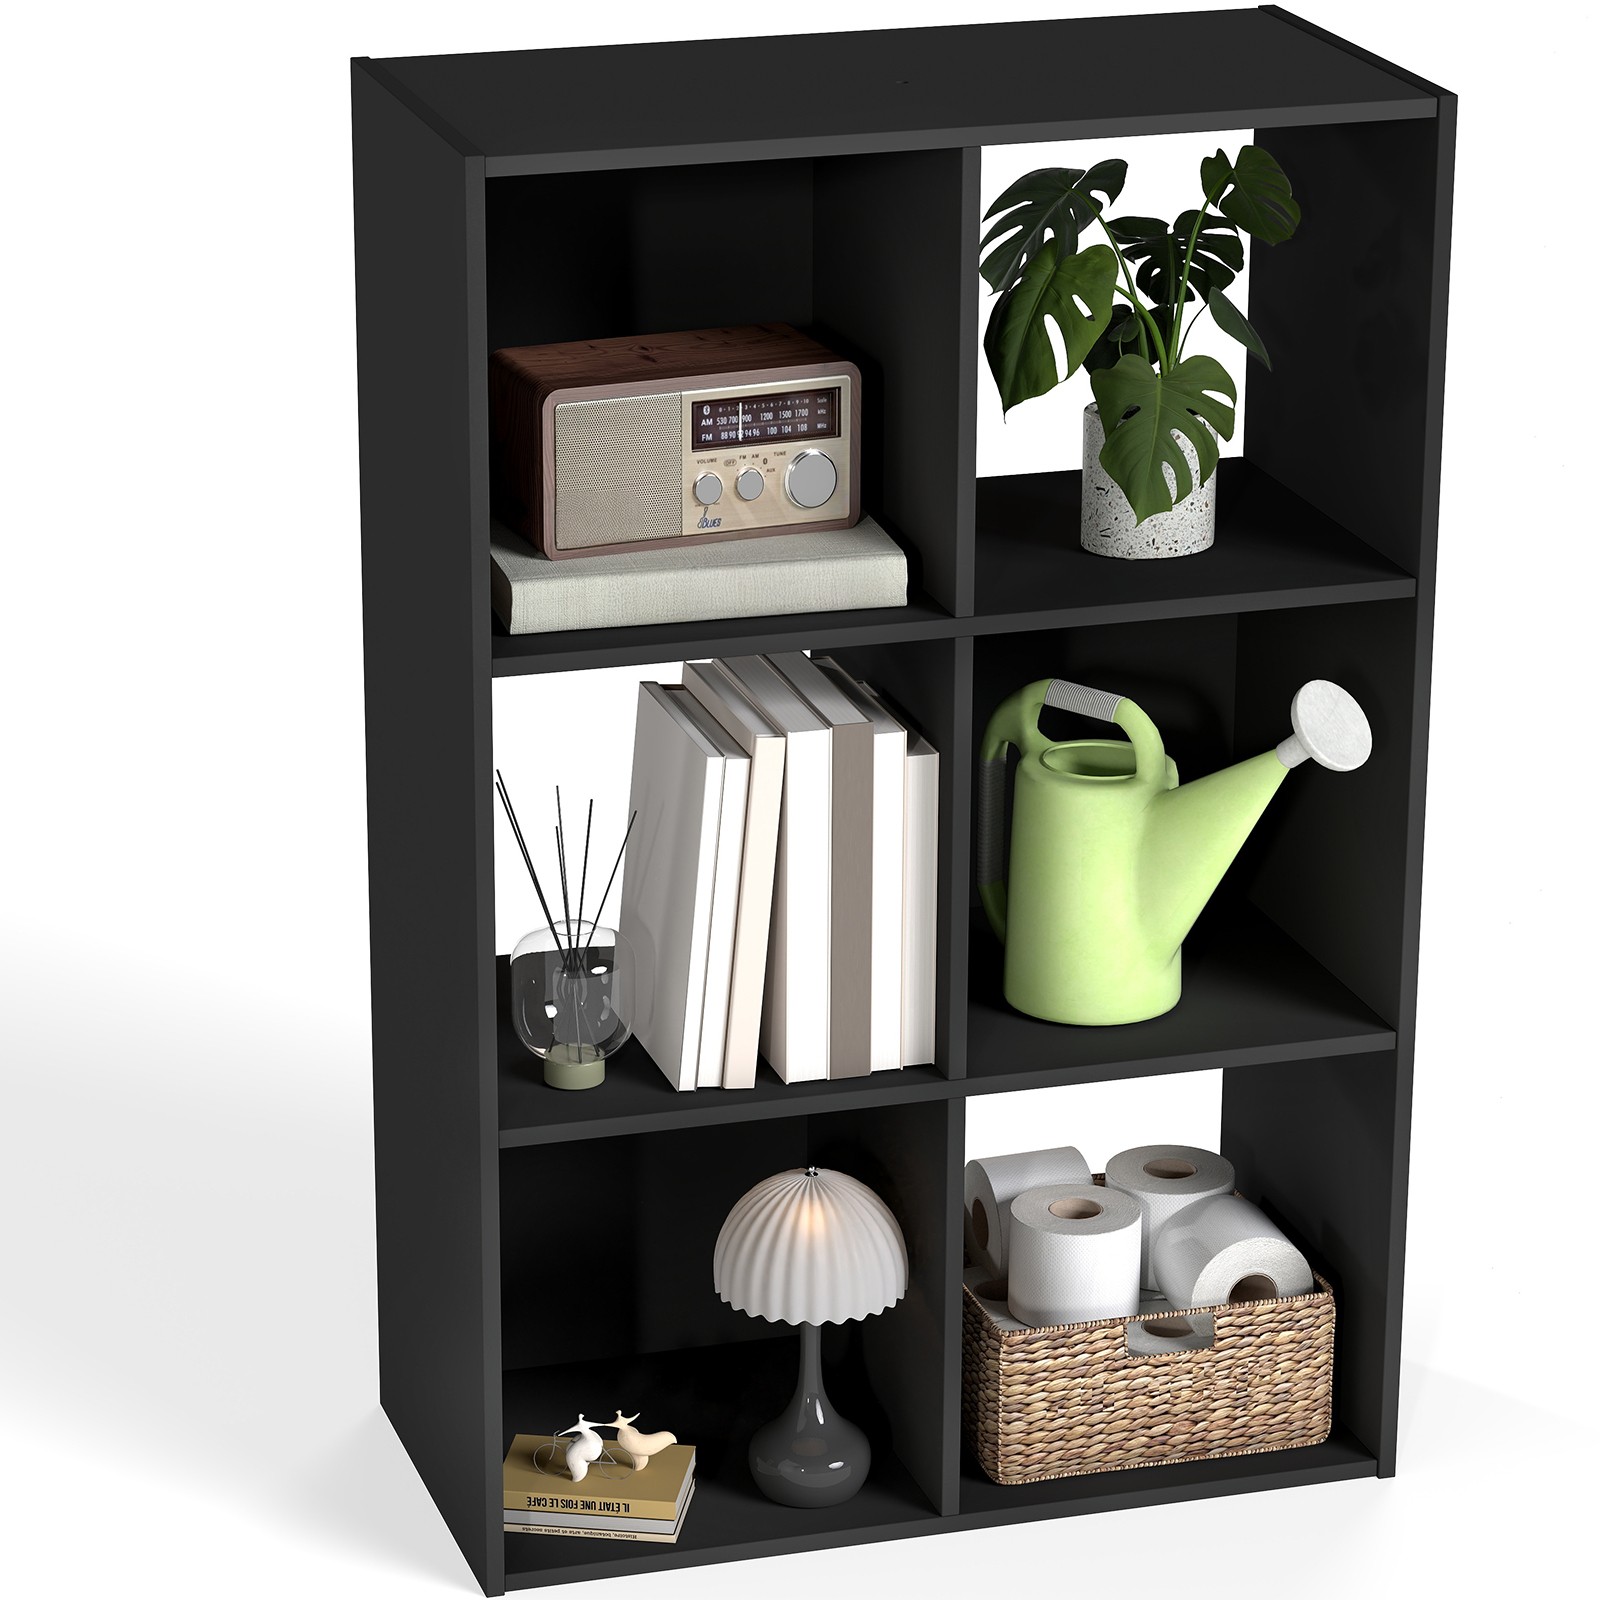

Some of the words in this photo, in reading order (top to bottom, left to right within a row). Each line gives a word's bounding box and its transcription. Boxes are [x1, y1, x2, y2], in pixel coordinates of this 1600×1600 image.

[701, 418, 713, 426] AM
[716, 416, 727, 425] 530
[728, 415, 738, 424] 700
[742, 414, 752, 422] 900
[760, 412, 773, 420] 1200
[779, 410, 792, 419] 1500
[795, 408, 809, 417] 1700
[721, 432, 728, 440] 88
[729, 431, 736, 439] 90
[745, 429, 752, 437] 94
[753, 428, 760, 436] 96
[767, 426, 778, 435] 100
[782, 425, 791, 434] 104
[798, 423, 808, 432] 108
[527, 1496, 547, 1508] CAFÉ
[549, 1498, 559, 1508] LE
[560, 1498, 578, 1509] FOIS
[580, 1500, 596, 1511] UNE
[599, 1501, 620, 1514] ÉTAIT
[622, 1503, 630, 1513] IL
